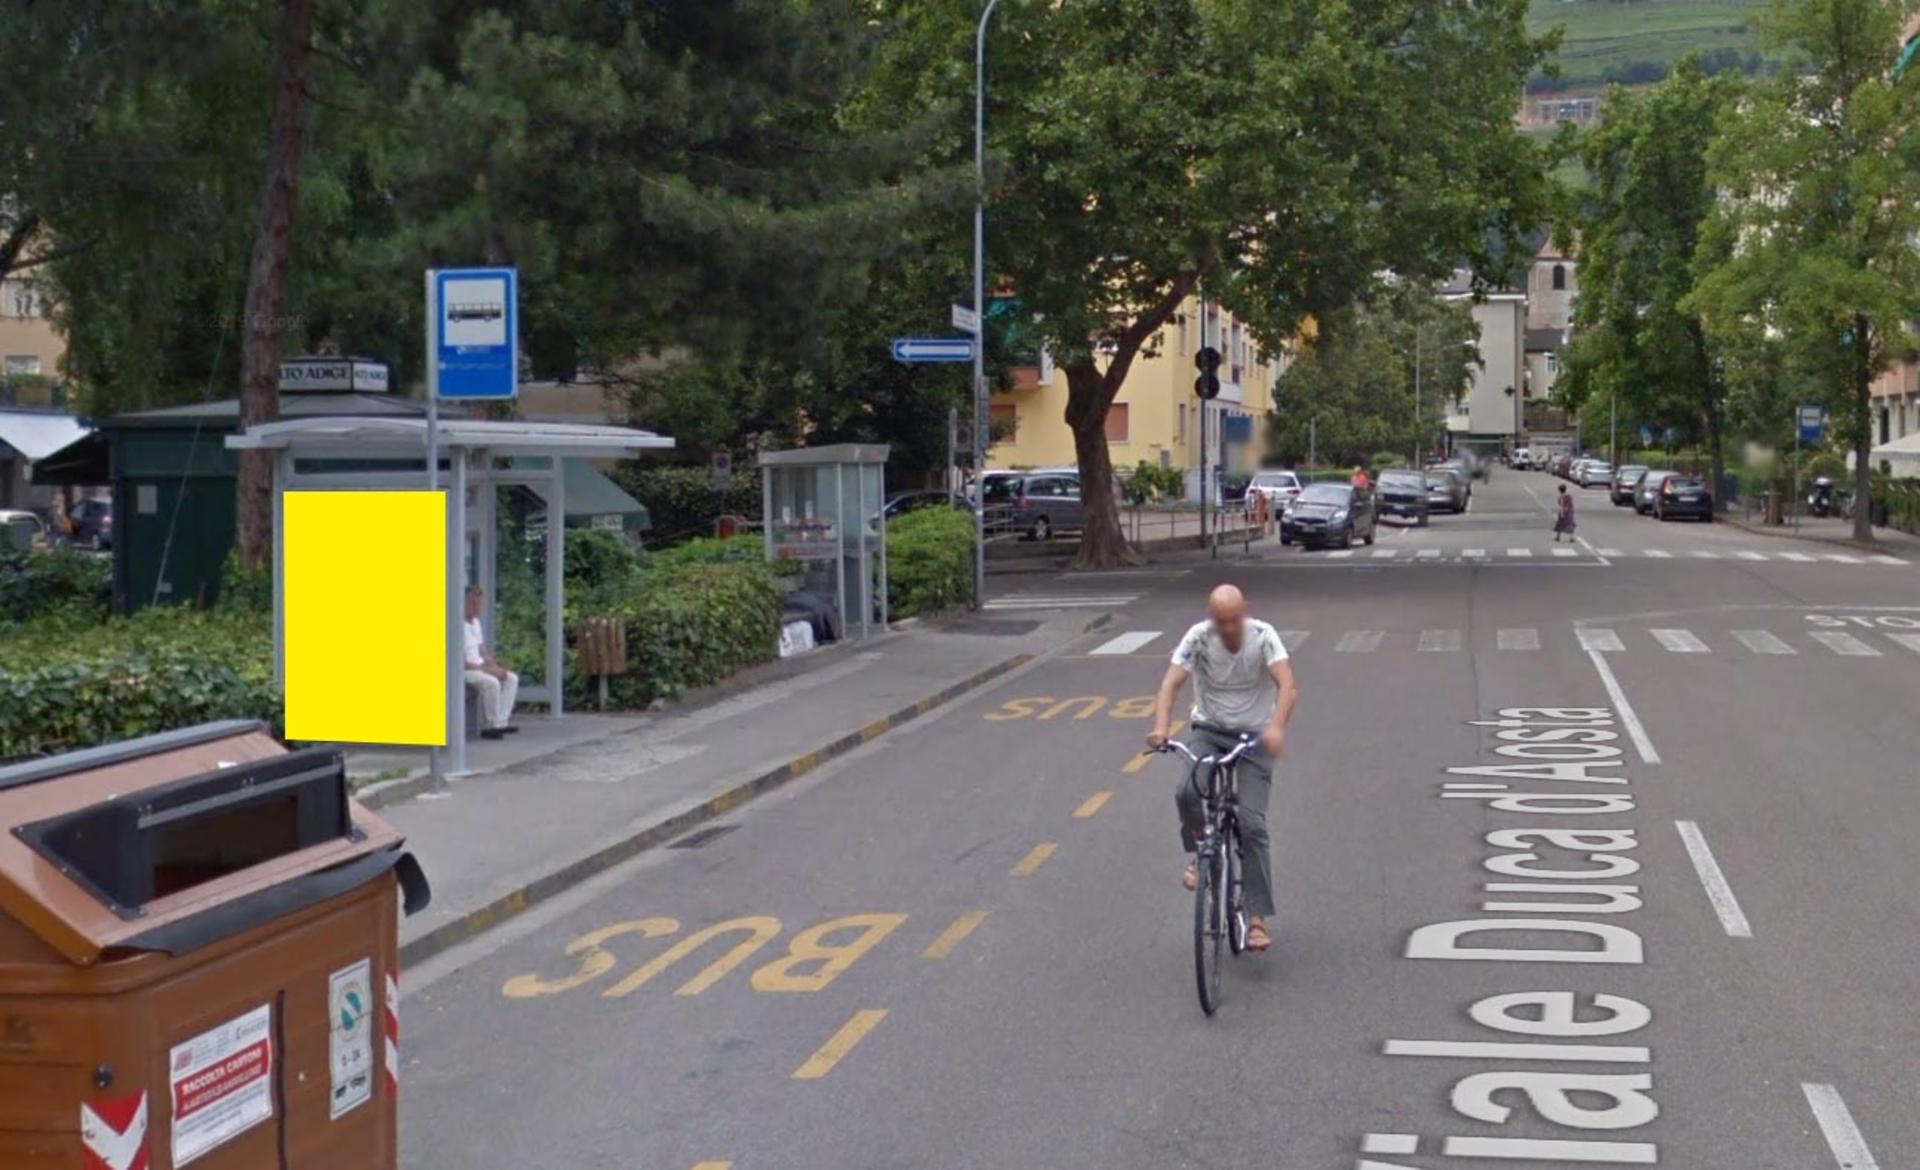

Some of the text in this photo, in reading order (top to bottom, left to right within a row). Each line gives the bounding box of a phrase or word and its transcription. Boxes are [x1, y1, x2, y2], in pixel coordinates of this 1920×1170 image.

[275, 367, 304, 380] LTO
[305, 366, 349, 380] ADIGE
[983, 695, 1160, 721] BUS
[501, 913, 908, 998] BUS
